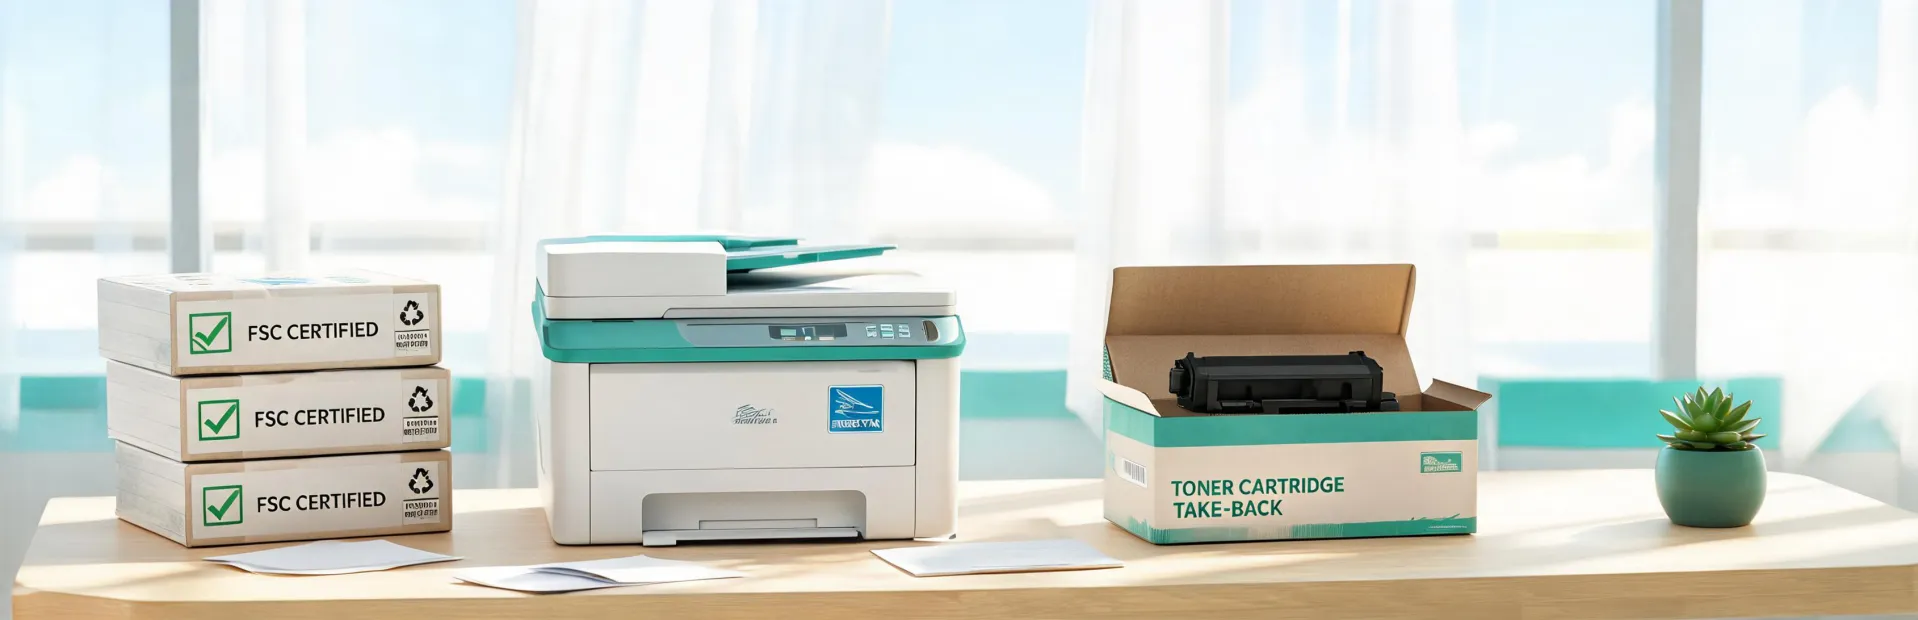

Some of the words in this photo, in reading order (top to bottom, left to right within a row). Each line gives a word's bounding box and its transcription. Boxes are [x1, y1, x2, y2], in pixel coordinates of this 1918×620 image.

[248, 324, 282, 342] FSC
[286, 321, 379, 340] CERTIFIED
[255, 410, 289, 428] FSC
[294, 407, 386, 426] CERTIFIED
[1170, 479, 1234, 497] TONER
[1238, 476, 1345, 496] CARTRIDGE
[257, 495, 291, 513] FSC
[295, 491, 387, 511] CERTIFIED
[1172, 499, 1283, 519] TAKE-BACK
